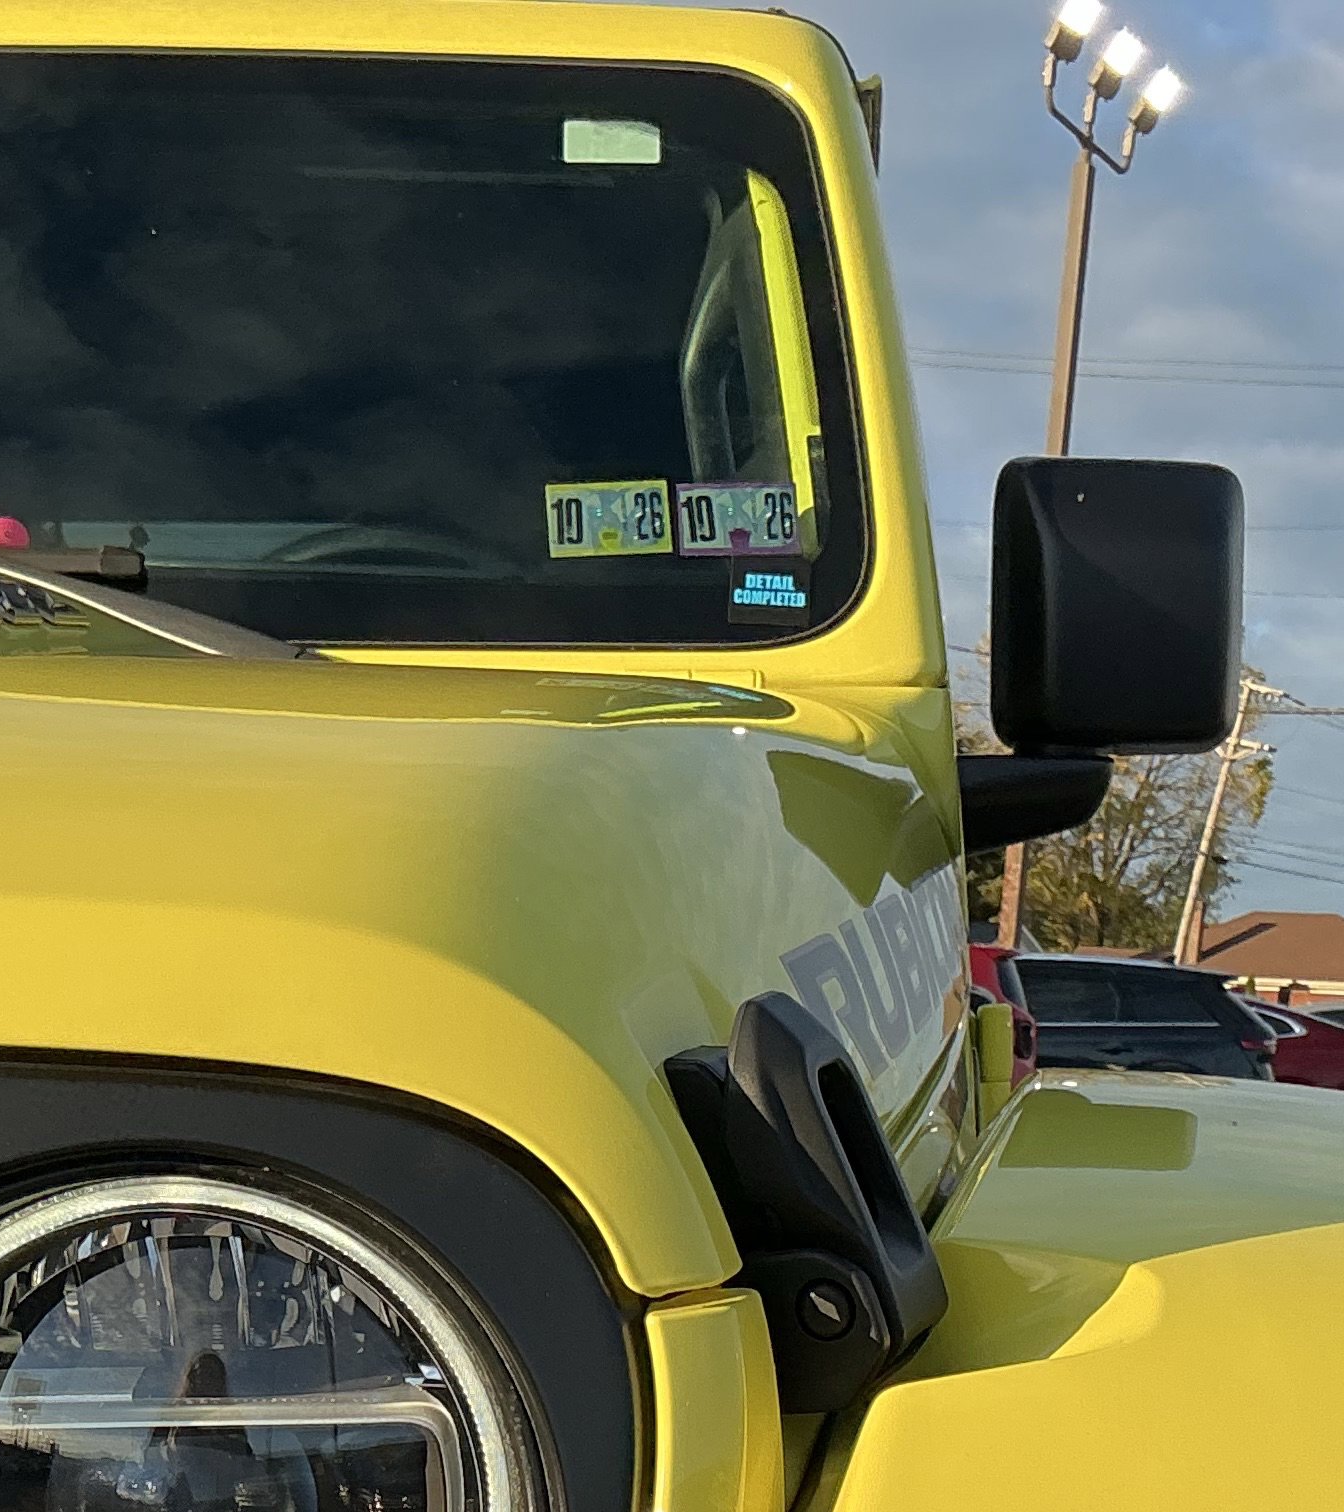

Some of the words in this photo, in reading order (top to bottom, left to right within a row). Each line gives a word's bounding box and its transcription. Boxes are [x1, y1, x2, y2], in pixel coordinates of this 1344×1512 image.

[551, 498, 584, 545] 10
[634, 491, 665, 541] 26
[681, 495, 717, 543] 10
[763, 492, 794, 541] 26
[733, 589, 806, 608] COMPLETED
[745, 573, 795, 590] DETAIL
